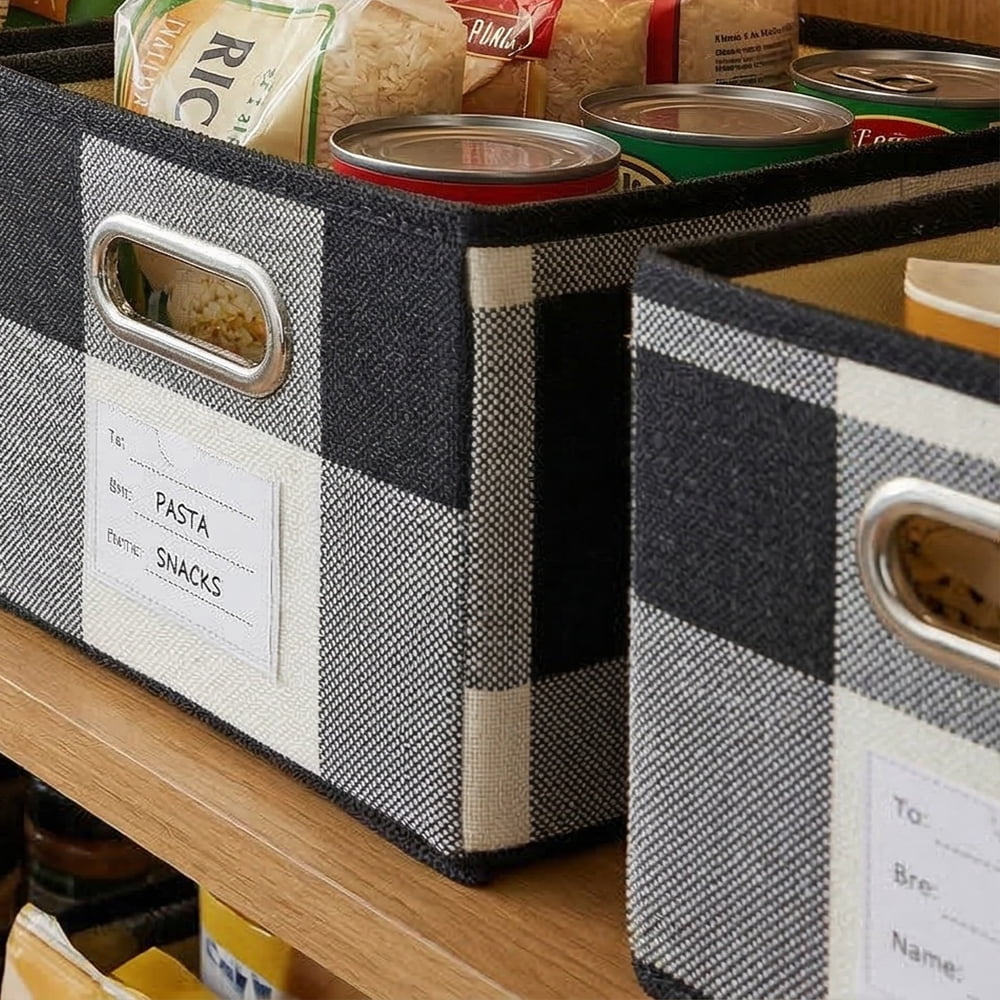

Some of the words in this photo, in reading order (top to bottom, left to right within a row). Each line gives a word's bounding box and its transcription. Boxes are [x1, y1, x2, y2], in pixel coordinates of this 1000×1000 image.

[174, 31, 256, 127] RIC
[156, 491, 210, 538] PASTA
[156, 547, 222, 598] SNACKS
[892, 794, 931, 828] To:
